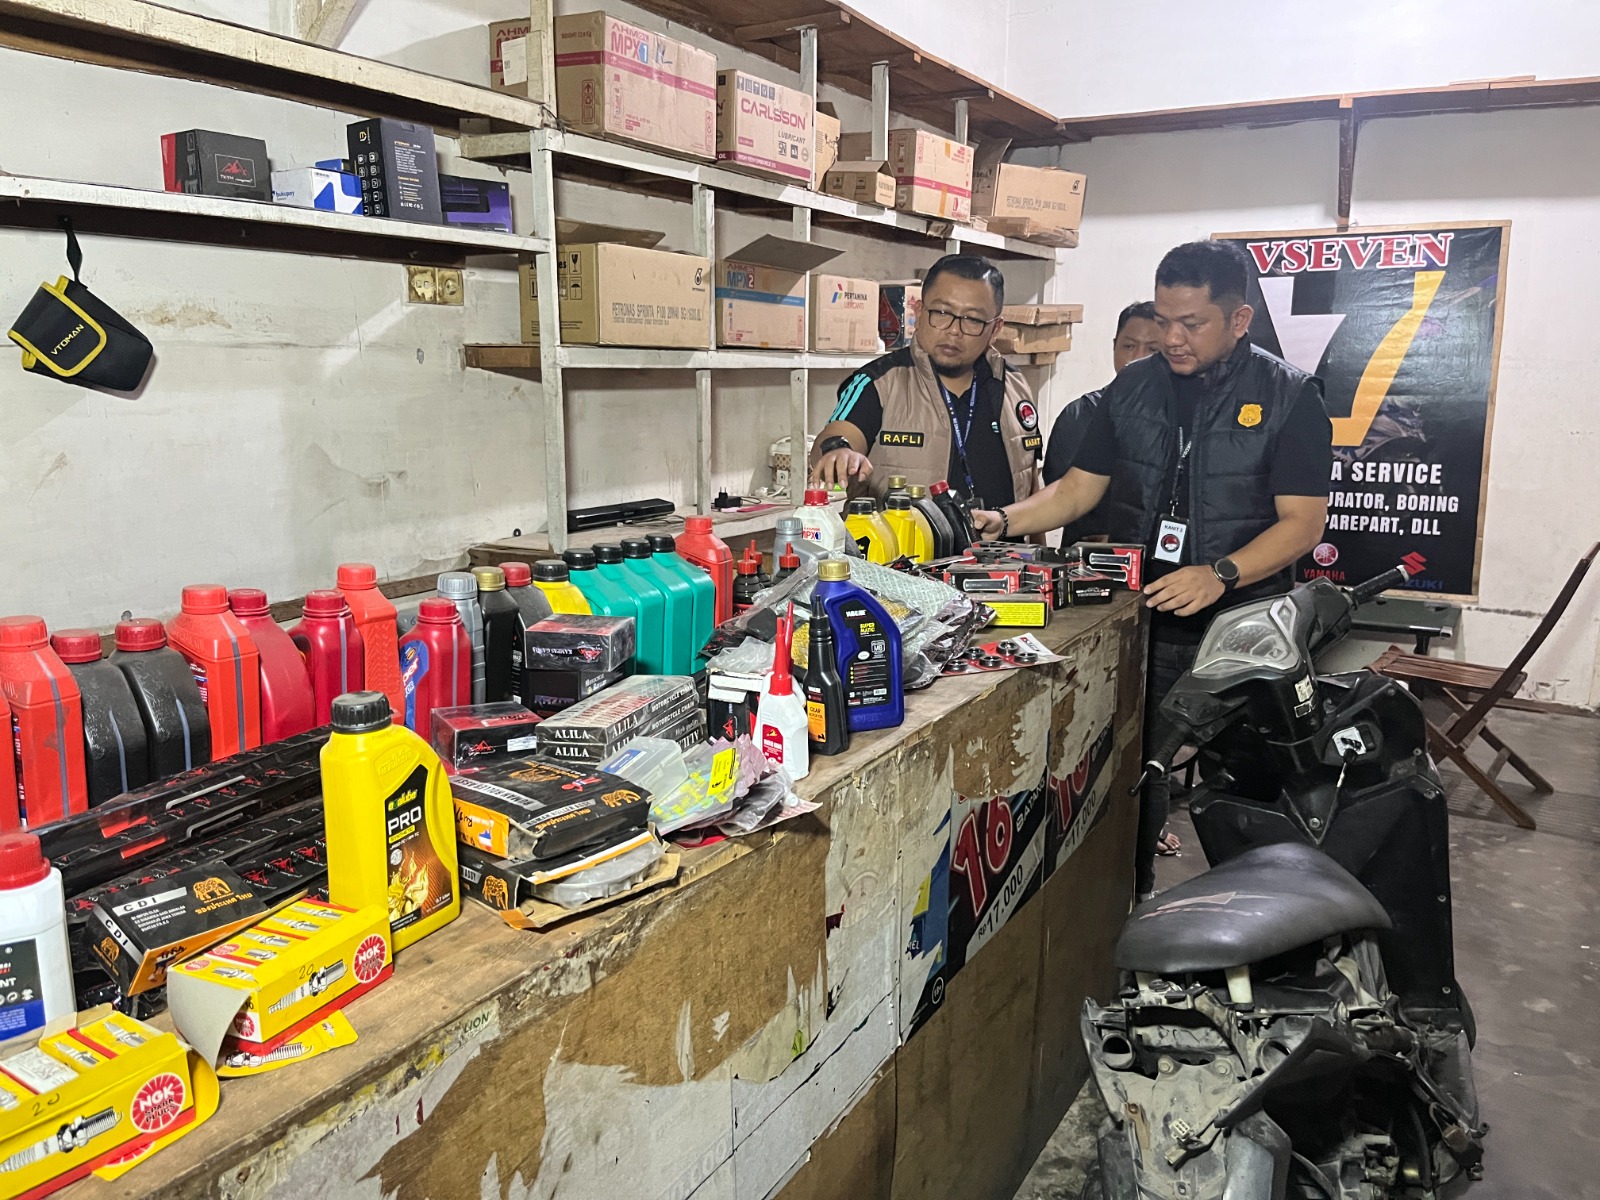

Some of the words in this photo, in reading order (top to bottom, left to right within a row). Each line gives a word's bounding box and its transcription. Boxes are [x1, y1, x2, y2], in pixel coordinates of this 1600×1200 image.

[740, 98, 806, 131] CARLSSON
[778, 130, 806, 145] LUBRICANT
[1247, 233, 1454, 274] VSEVEN
[844, 291, 868, 301] PERTAMINA
[612, 302, 635, 317] PETRONAS
[51, 323, 85, 355] VTOMAN
[883, 433, 922, 445] RAFLI
[1351, 461, 1443, 485] SERVICE
[1396, 494, 1459, 513] BORING
[1411, 518, 1441, 536] DLL
[1304, 568, 1345, 581] YAMAHA
[1397, 579, 1444, 590] ZUKI
[651, 692, 680, 713] MOTORCYCLE
[651, 709, 681, 730] MOTORCYCLE
[681, 700, 695, 713] CHAIN
[554, 729, 590, 740] ALILA
[612, 714, 639, 739] ALILA
[555, 746, 590, 758] ALILA
[1015, 776, 1046, 833] BATANG
[387, 805, 422, 836] PRO
[390, 826, 414, 842] SYNTHETIC
[951, 795, 1014, 919] 16
[464, 868, 477, 882] ASSY
[123, 896, 158, 913] CDI
[105, 919, 129, 946] CDI
[358, 942, 381, 963] NGK
[298, 963, 315, 980] 20
[31, 1092, 60, 1117] 20
[138, 1084, 175, 1112] NGK
[144, 1097, 175, 1116] SPARK
[145, 1103, 176, 1123] PLUGS
